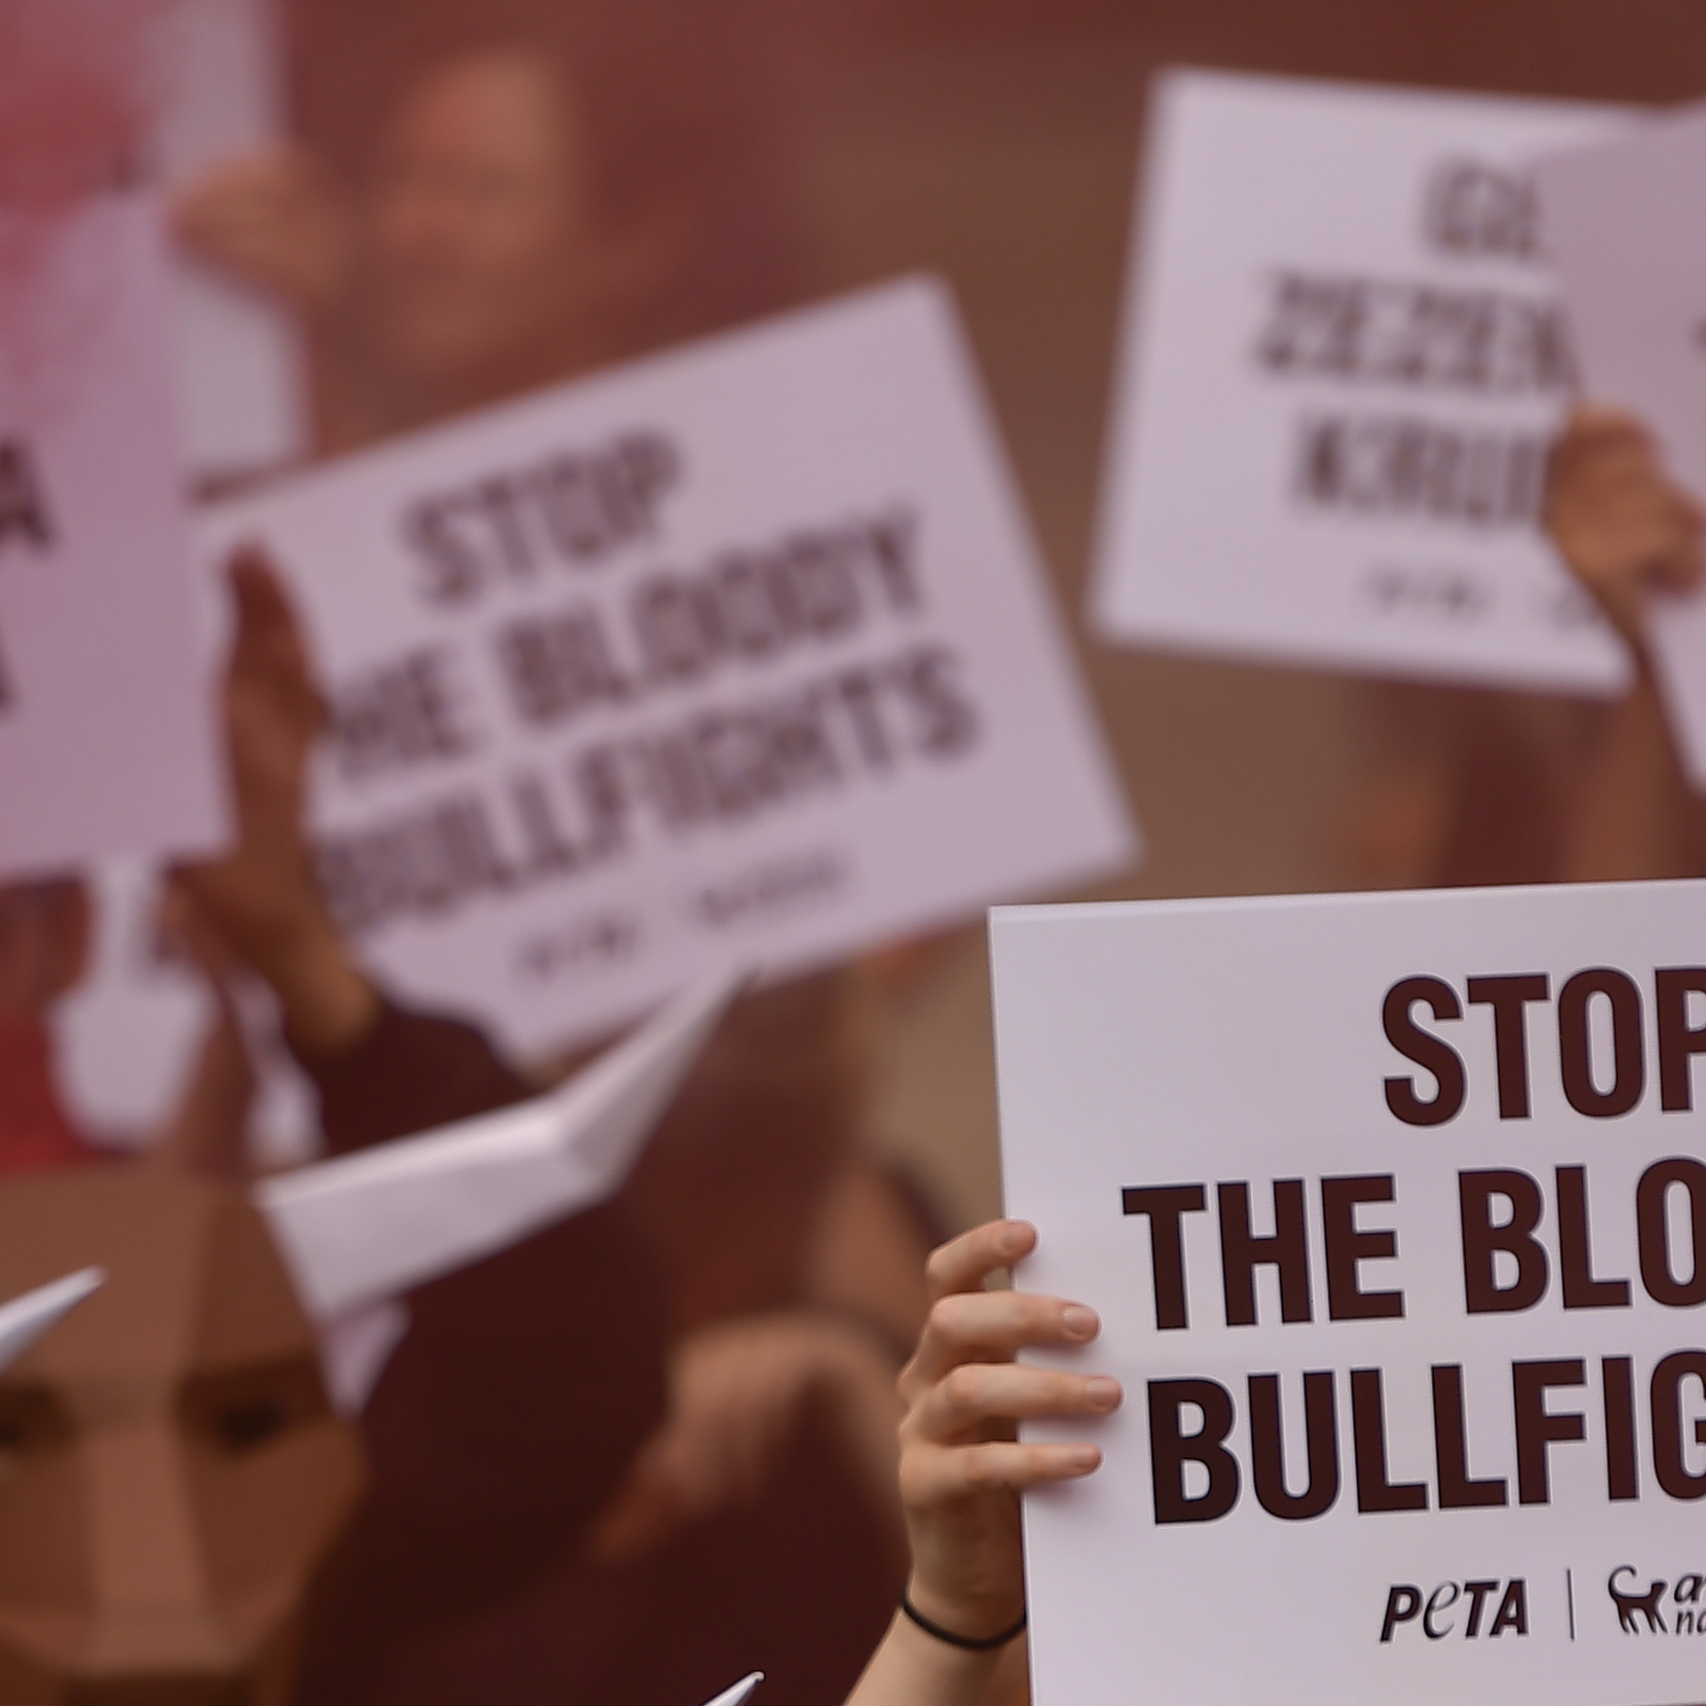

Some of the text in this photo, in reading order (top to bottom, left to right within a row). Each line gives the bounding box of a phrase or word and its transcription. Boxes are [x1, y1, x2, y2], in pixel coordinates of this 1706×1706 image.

[404, 433, 677, 606] STOP
[330, 520, 916, 780] HE BLOODY
[1121, 1174, 1404, 1331] THE
